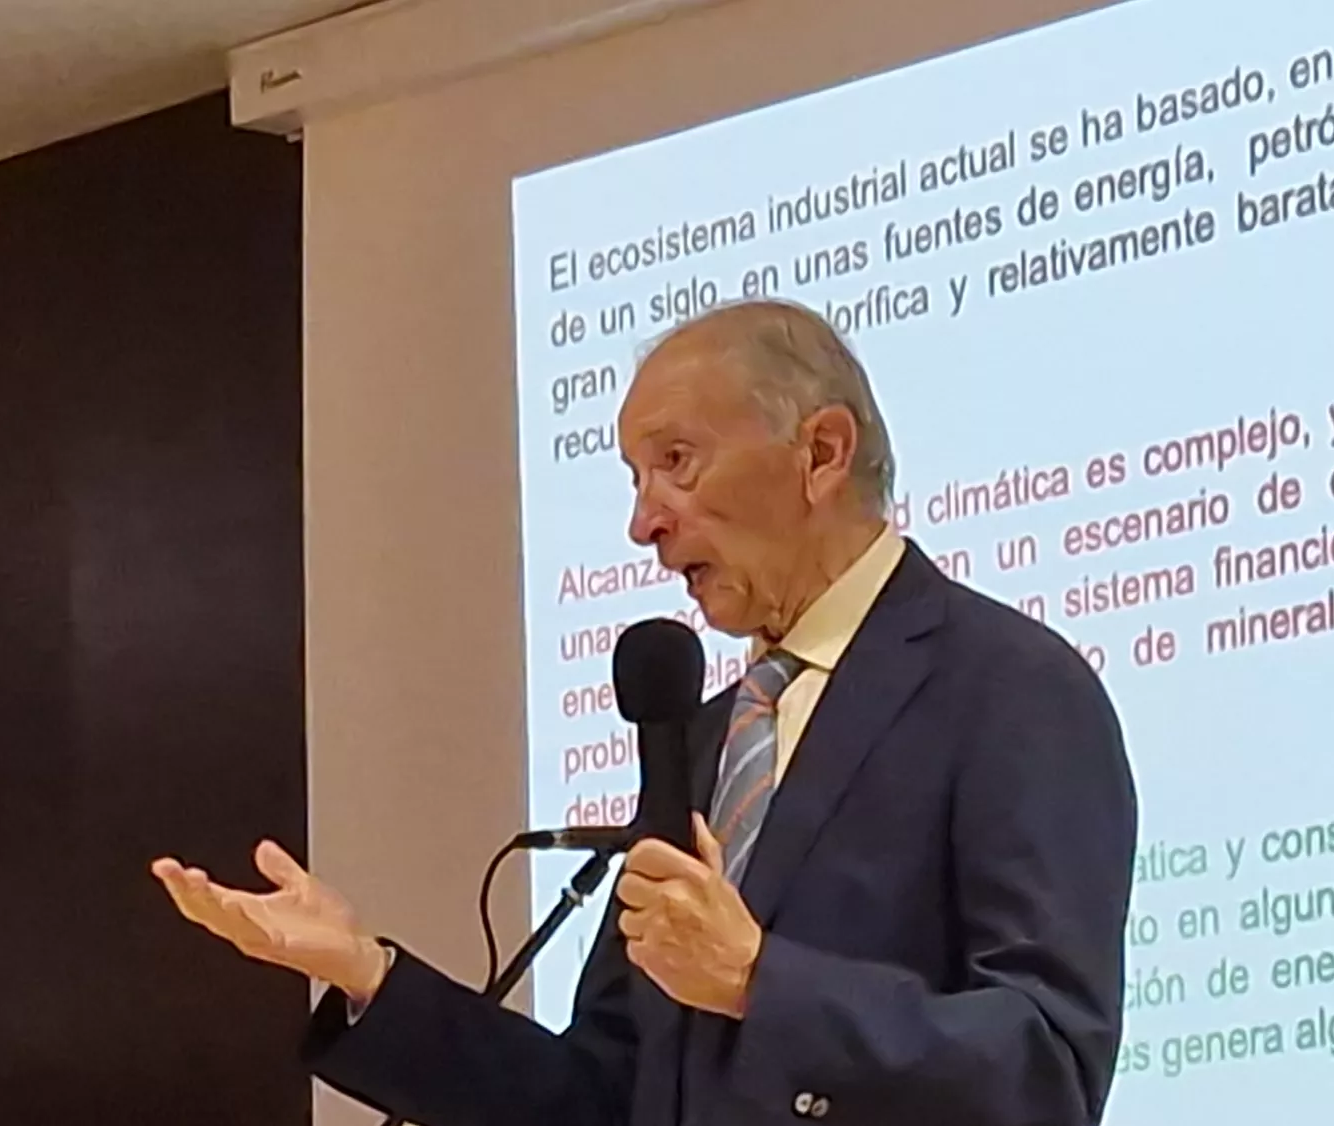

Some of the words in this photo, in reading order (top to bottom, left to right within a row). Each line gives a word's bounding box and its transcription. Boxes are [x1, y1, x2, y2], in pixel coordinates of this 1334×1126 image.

[550, 249, 577, 292] El
[588, 211, 755, 281] ecosistema
[769, 160, 906, 234] industrial
[920, 129, 1015, 192] actual
[1030, 125, 1068, 163] se
[1081, 108, 1123, 148] ha
[1137, 65, 1275, 133] basado,
[1287, 47, 1333, 89] en
[551, 309, 586, 347] de
[600, 302, 635, 336] un
[742, 265, 779, 299] en
[794, 241, 869, 286] unas
[884, 205, 1002, 263] fuentes
[1017, 184, 1059, 227] de
[1074, 143, 1214, 212] energía,
[552, 365, 616, 415] gran
[826, 284, 929, 334] lorífica
[949, 276, 968, 319] y
[988, 206, 1215, 298] relativamente
[554, 419, 616, 462] recu
[927, 465, 1069, 525] climática
[1086, 453, 1126, 489] es
[1144, 406, 1310, 476] complejo,
[997, 536, 1036, 571] un
[1064, 486, 1229, 556] escenario
[1257, 471, 1301, 514] de
[563, 681, 613, 718] ene
[1065, 562, 1194, 618] sistema
[565, 727, 633, 784] probl
[1134, 624, 1175, 666] de
[566, 793, 637, 826] deter
[1226, 838, 1245, 880] y
[1178, 906, 1219, 938] en
[1208, 956, 1249, 998] de
[1162, 1023, 1283, 1078] genera
